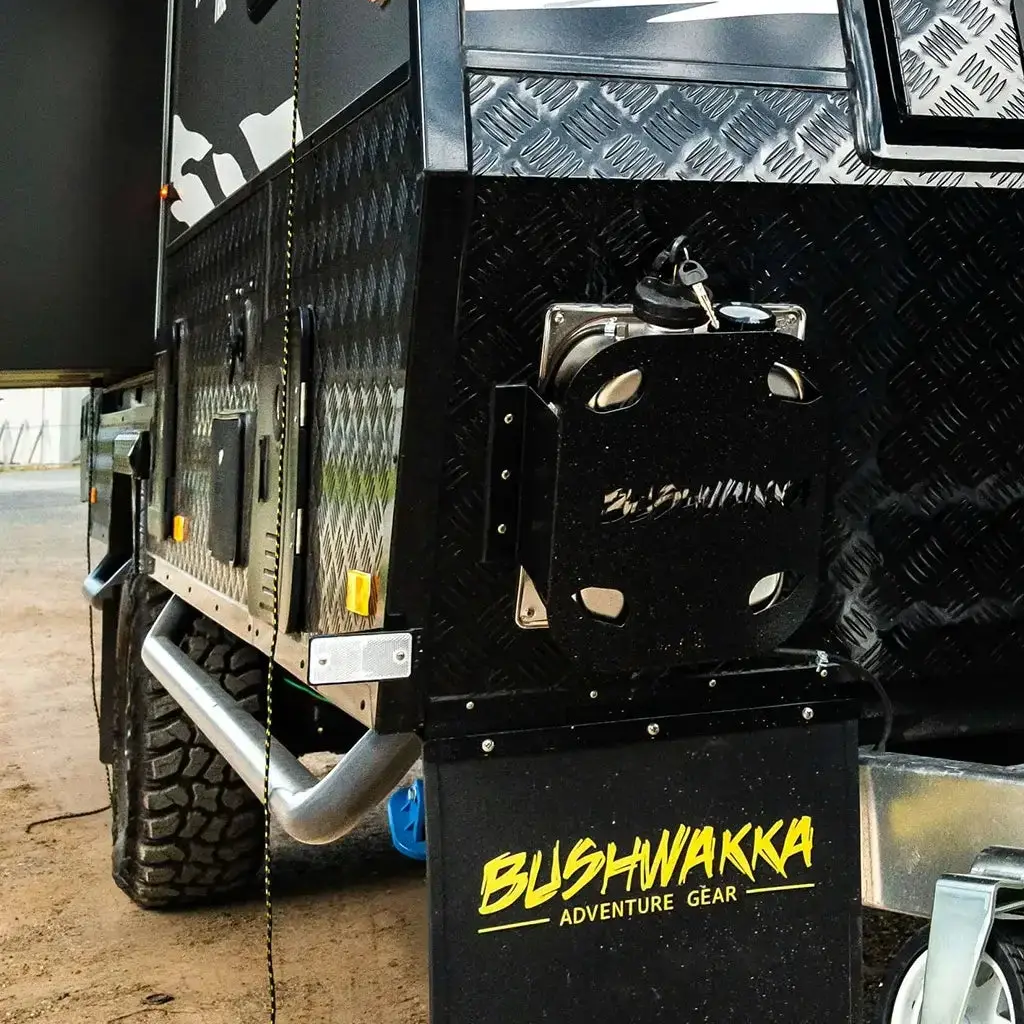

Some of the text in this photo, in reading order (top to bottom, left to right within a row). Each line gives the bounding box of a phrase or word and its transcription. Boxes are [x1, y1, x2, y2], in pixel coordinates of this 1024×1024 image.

[478, 815, 814, 915] BUSHWAKKA
[560, 885, 738, 927] ADVENTURE GEAR
